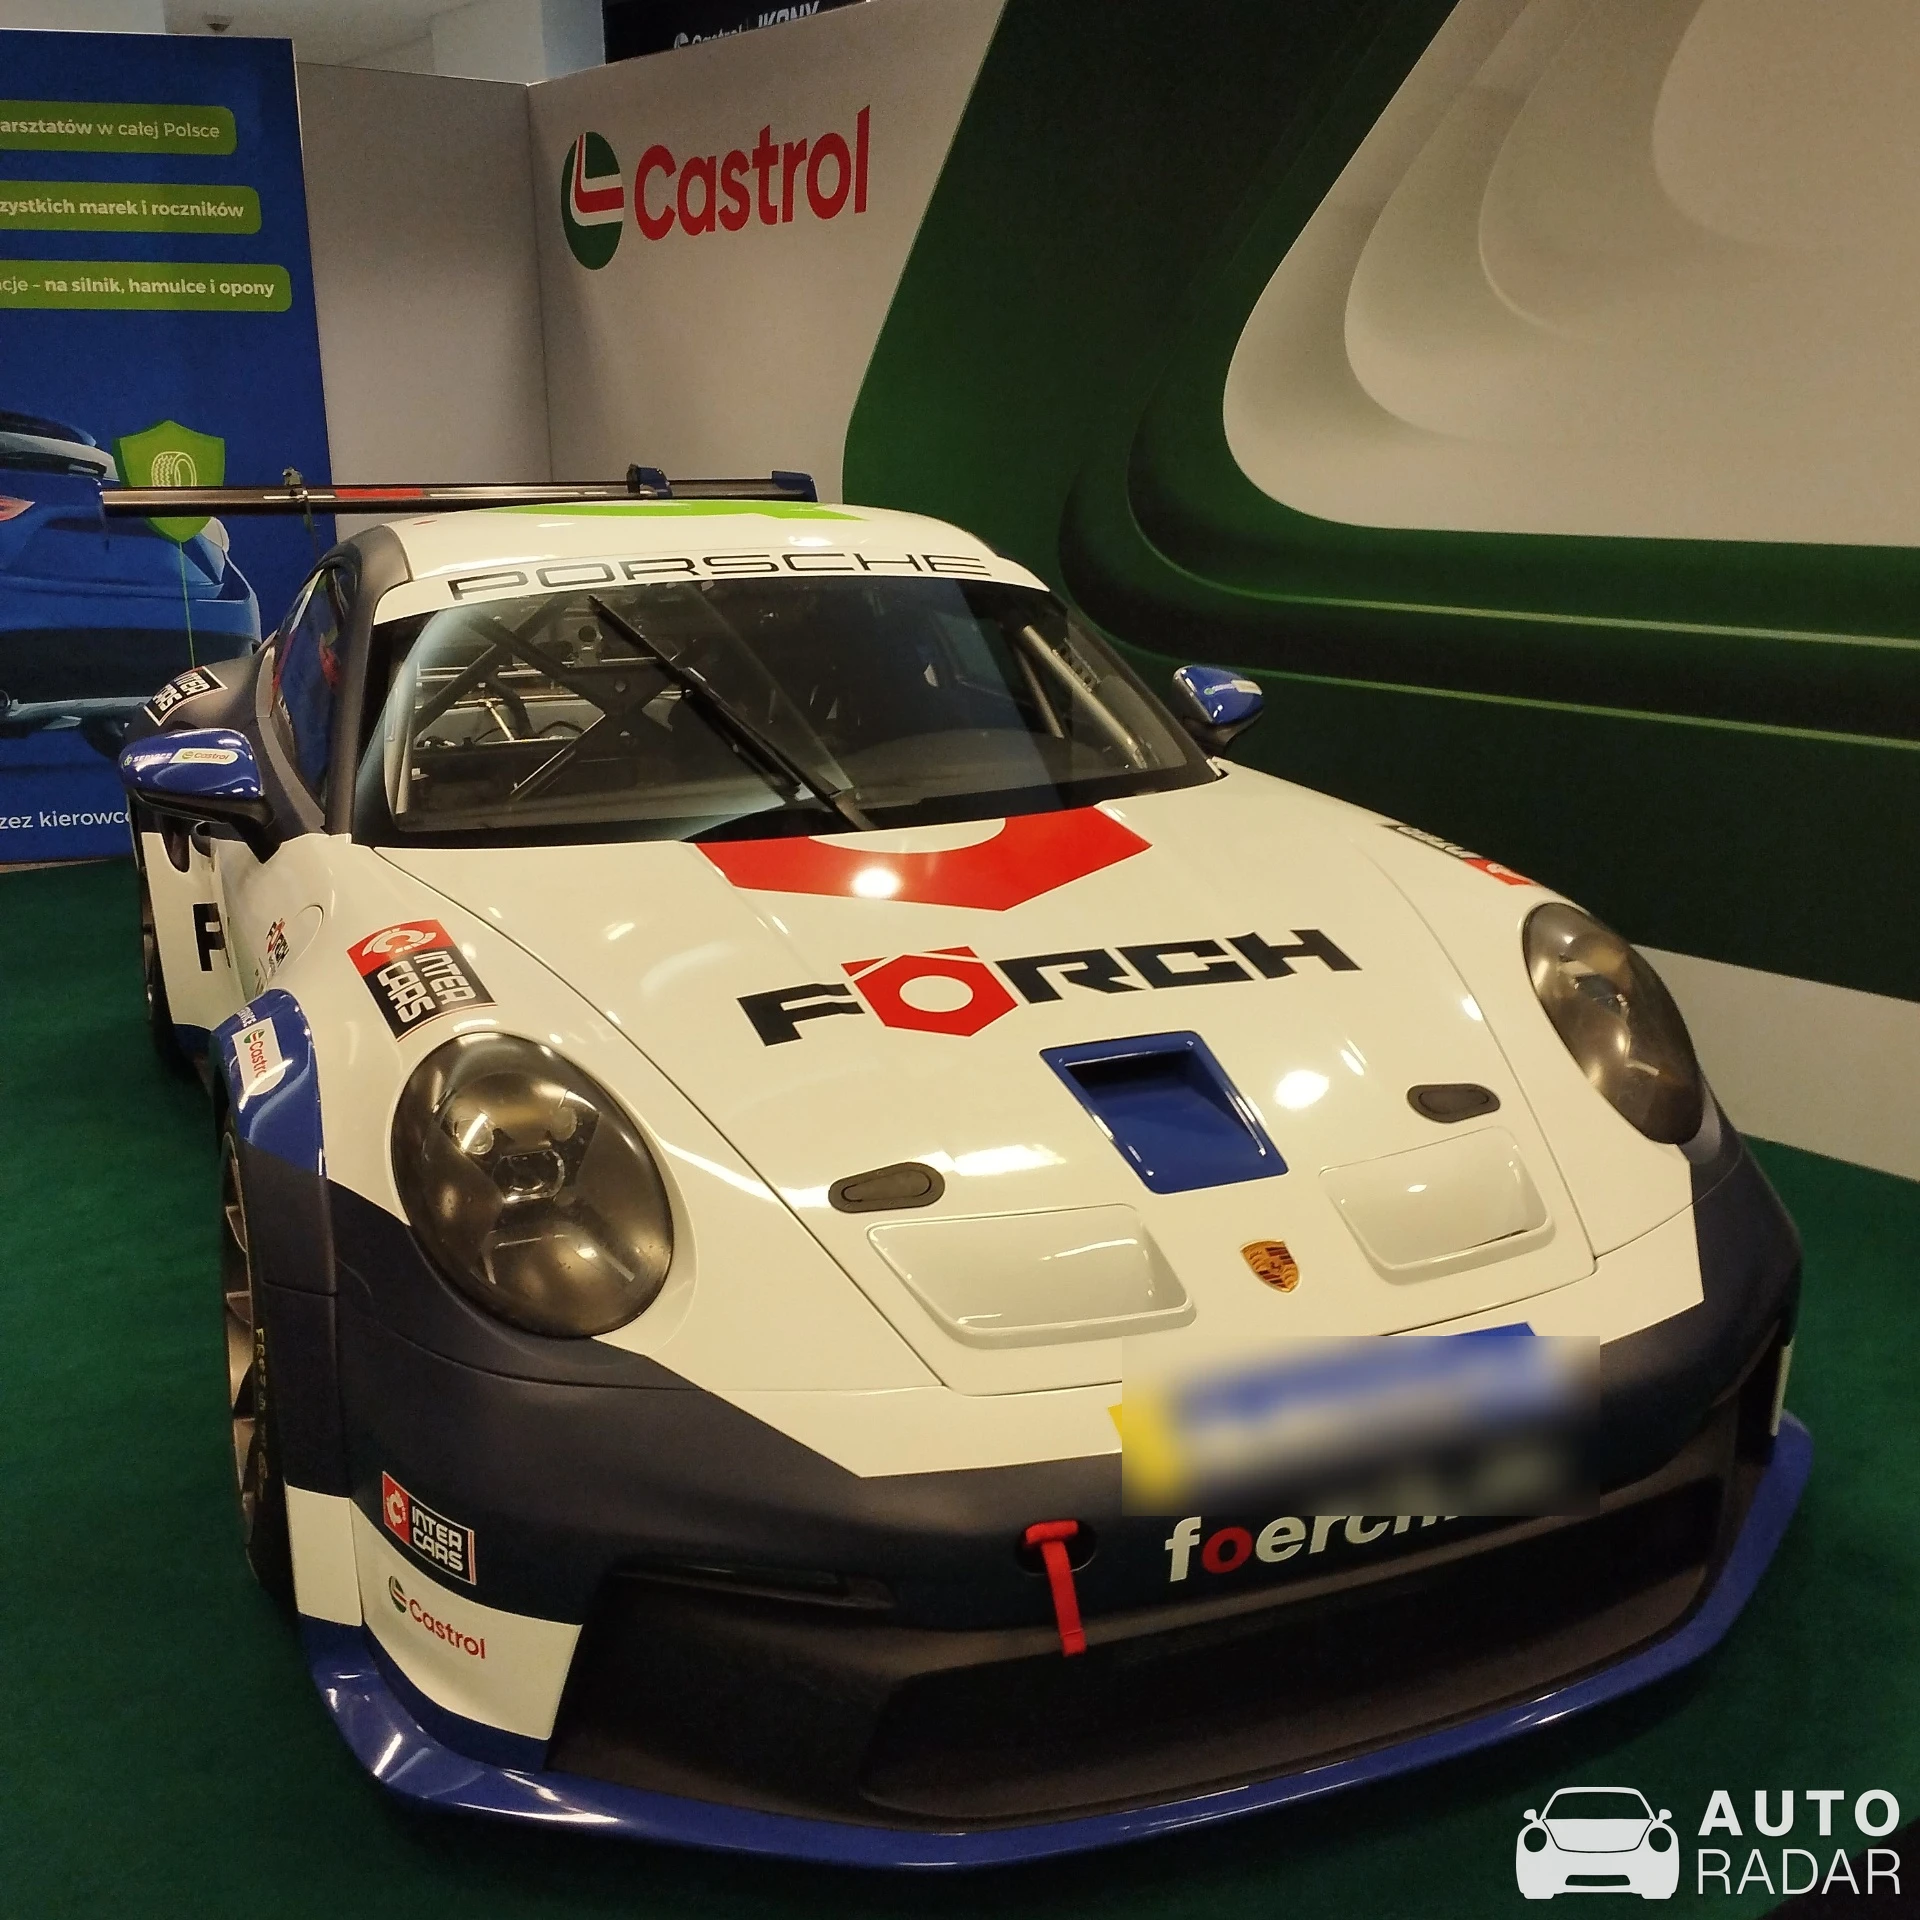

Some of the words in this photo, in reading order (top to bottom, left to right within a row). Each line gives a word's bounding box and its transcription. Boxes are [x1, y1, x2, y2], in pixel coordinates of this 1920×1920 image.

[98, 123, 114, 135] w
[118, 122, 158, 140] całej
[164, 122, 220, 138] Polsce
[634, 104, 870, 241] Castrol
[80, 200, 138, 214] marek
[142, 201, 147, 215] i
[152, 201, 244, 217] roczników
[45, 280, 67, 292] na
[71, 277, 124, 295] silnik,
[129, 279, 206, 294] hamulce
[210, 279, 215, 294] i
[220, 284, 275, 298] opony
[447, 553, 993, 601] PORSCHE
[193, 752, 230, 761] Castrol
[377, 960, 436, 1023] CARS
[413, 950, 477, 1005] INTER
[412, 1505, 463, 1552] INTER
[412, 1526, 463, 1572] CARS
[409, 1598, 486, 1660] Castrol
